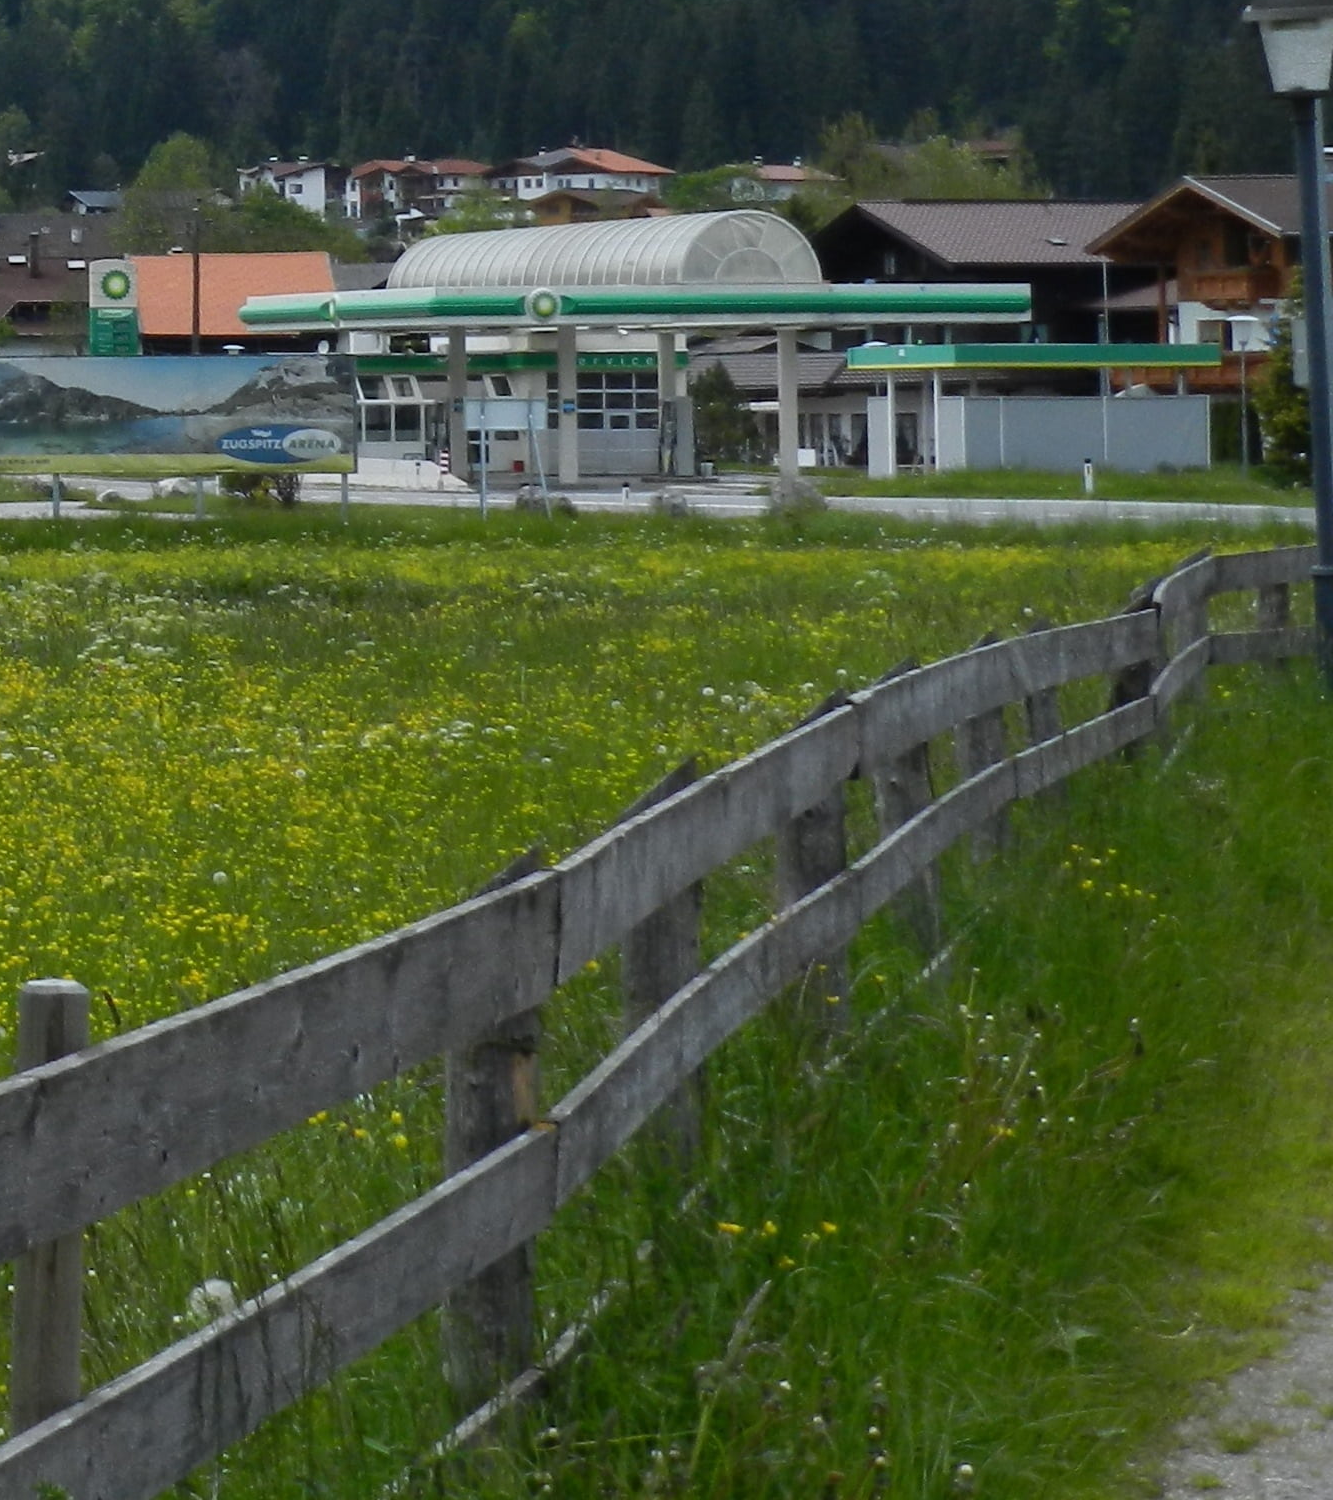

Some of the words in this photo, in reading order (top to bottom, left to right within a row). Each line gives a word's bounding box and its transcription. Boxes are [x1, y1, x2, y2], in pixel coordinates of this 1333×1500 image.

[578, 357, 653, 366] ervice
[221, 439, 282, 450] ZUGSPITZ
[288, 439, 336, 449] ARENA
